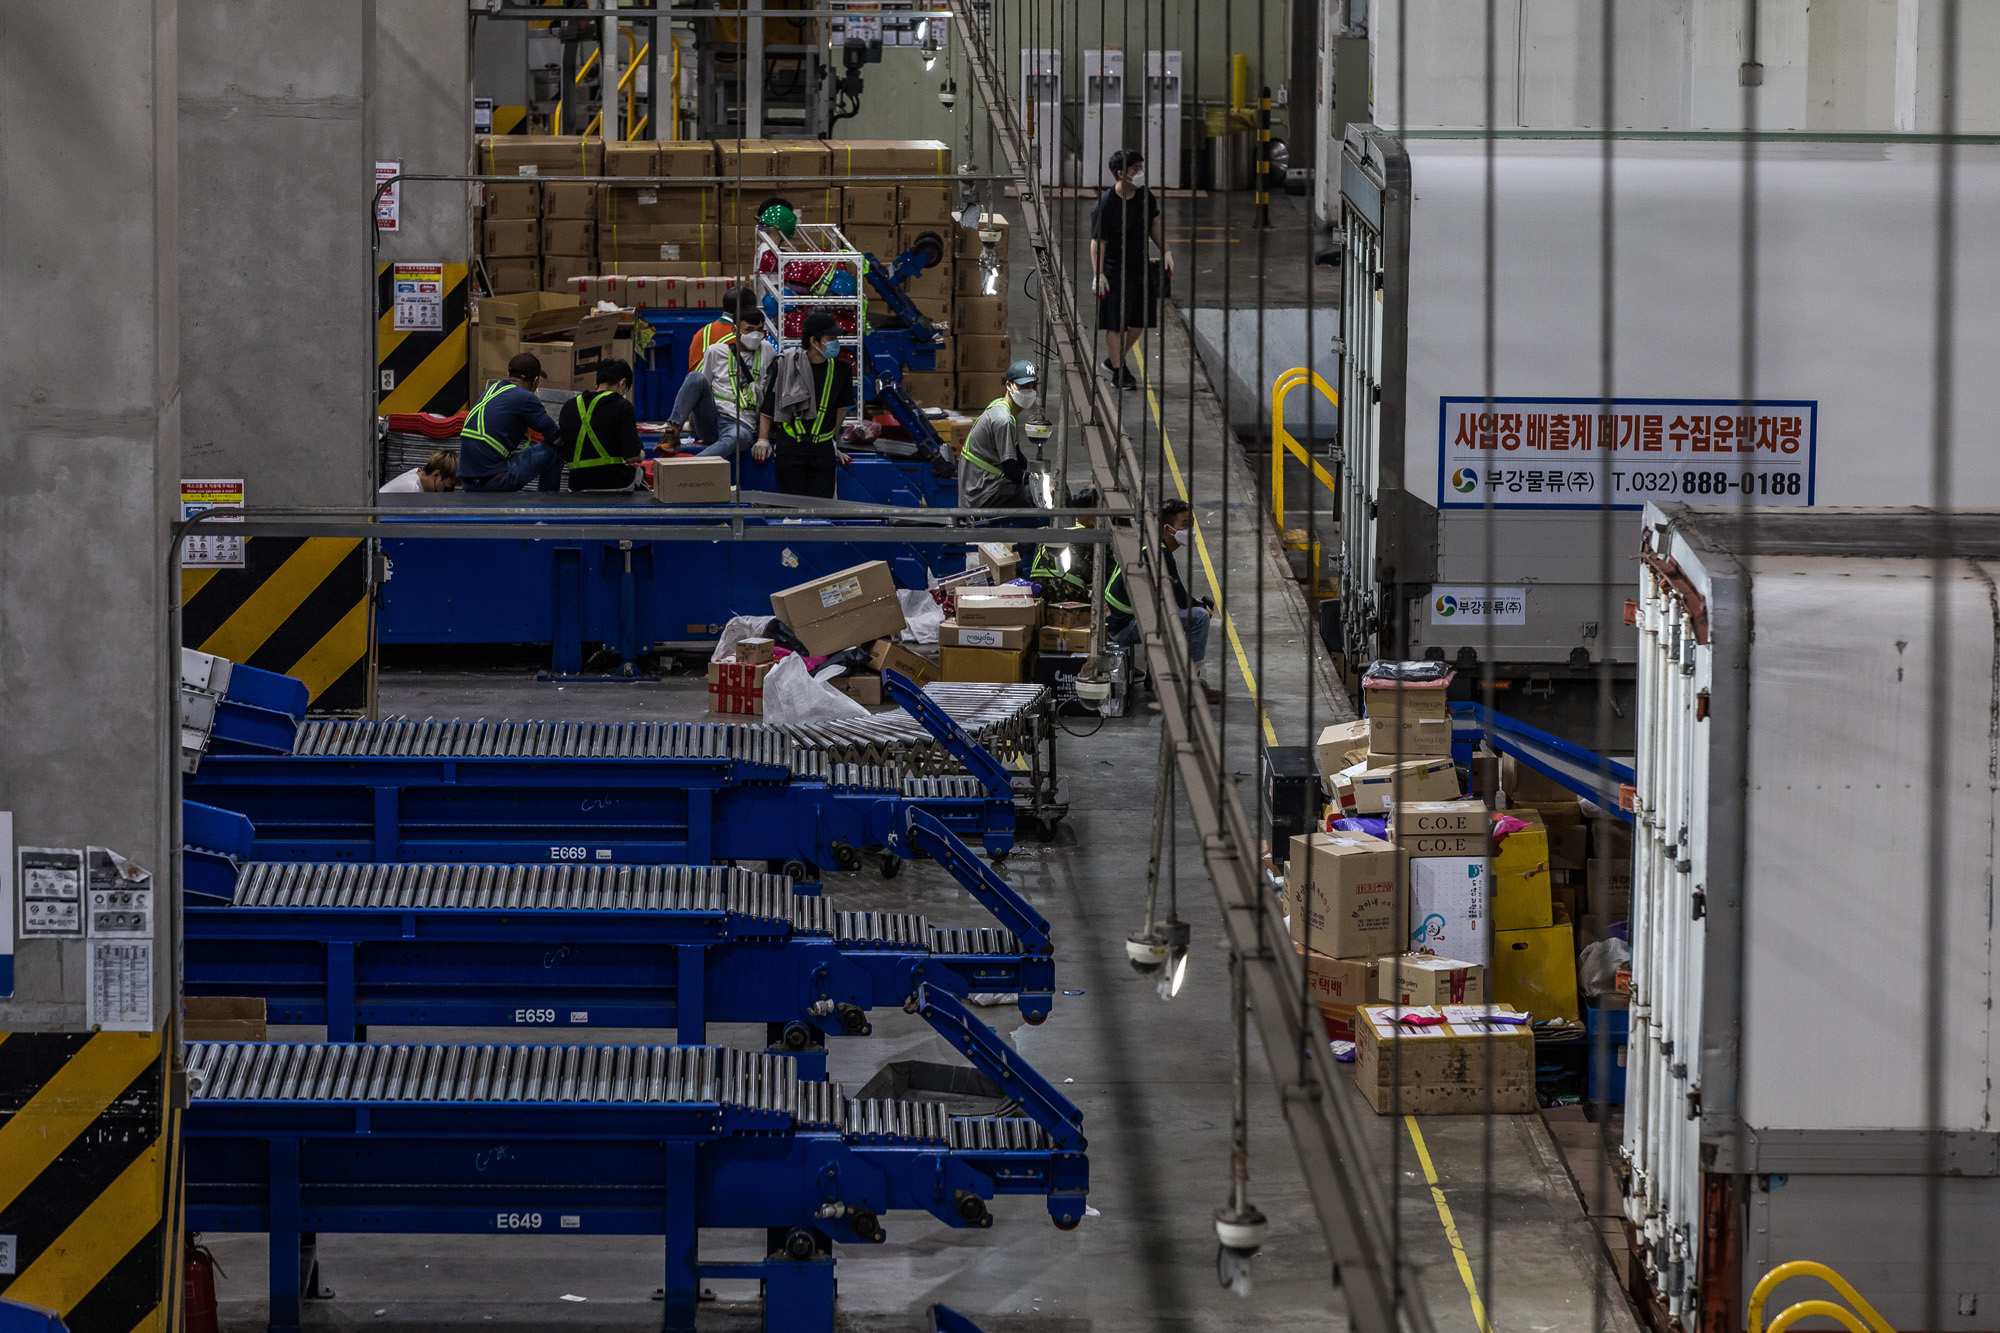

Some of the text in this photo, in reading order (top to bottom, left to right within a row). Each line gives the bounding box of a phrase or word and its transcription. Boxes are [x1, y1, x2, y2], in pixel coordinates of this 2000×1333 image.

[1454, 412, 1802, 454] 사업장 배출계 폐기물 수집운반차량
[1484, 469, 1595, 493] 부강물류(주)
[1459, 601, 1522, 614] 부강물류(주)
[550, 846, 587, 860] E669
[515, 1008, 556, 1023] E659
[497, 1213, 542, 1229] E649
